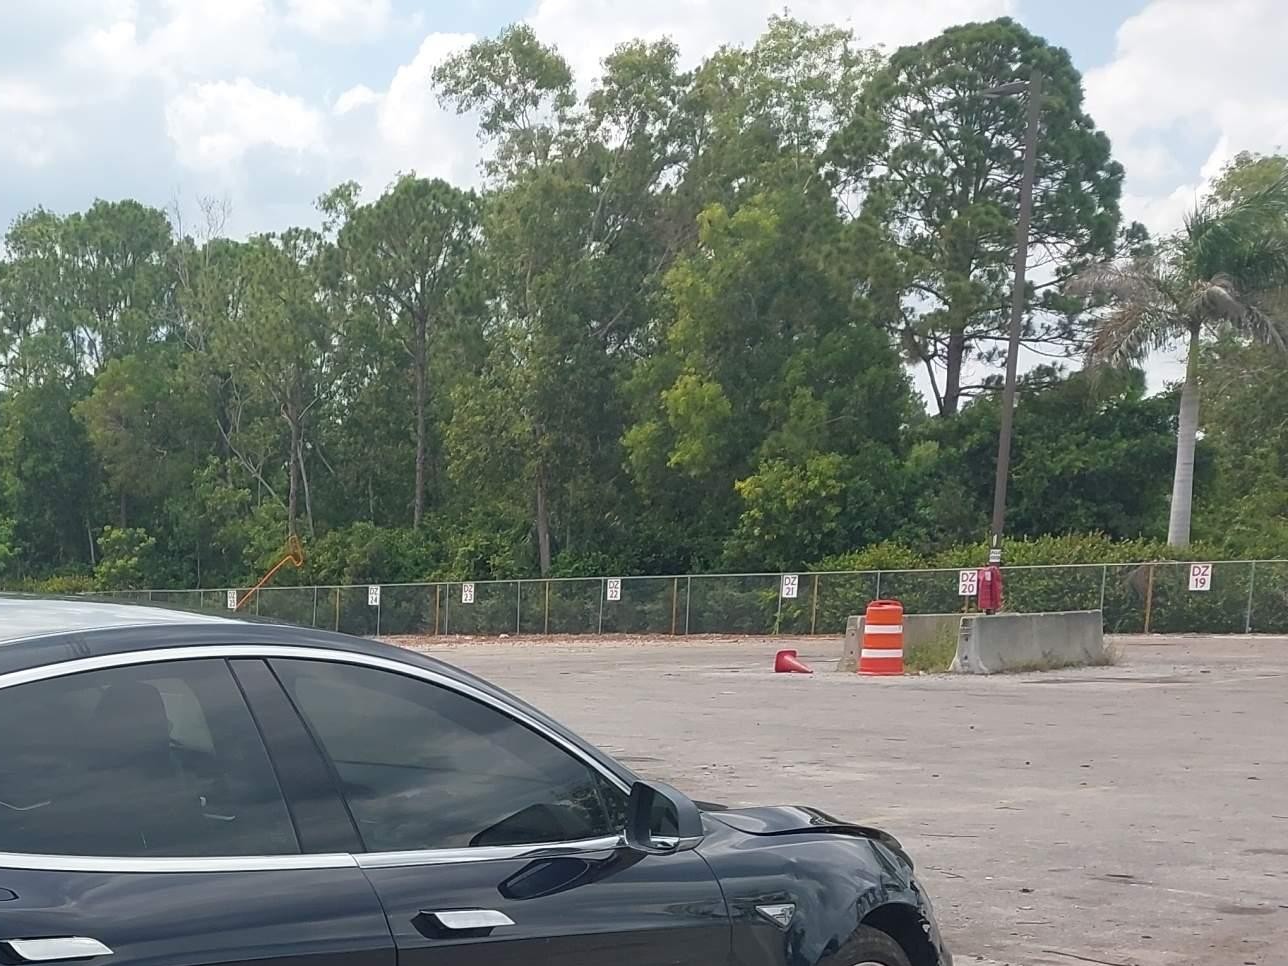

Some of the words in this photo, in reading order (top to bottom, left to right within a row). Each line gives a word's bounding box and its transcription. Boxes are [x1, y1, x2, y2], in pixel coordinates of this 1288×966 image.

[1192, 565, 1209, 577] DZ
[784, 576, 797, 586] DZ
[961, 572, 976, 583] DZ
[608, 580, 619, 589] DZ
[961, 583, 975, 593] 20
[1195, 577, 1206, 589] 19
[369, 587, 378, 595] DZ
[463, 584, 473, 593] DZ
[785, 586, 794, 596] 21
[229, 591, 236, 599] DZ
[463, 593, 473, 602] 23
[609, 589, 618, 599] 22
[370, 595, 378, 604] 24
